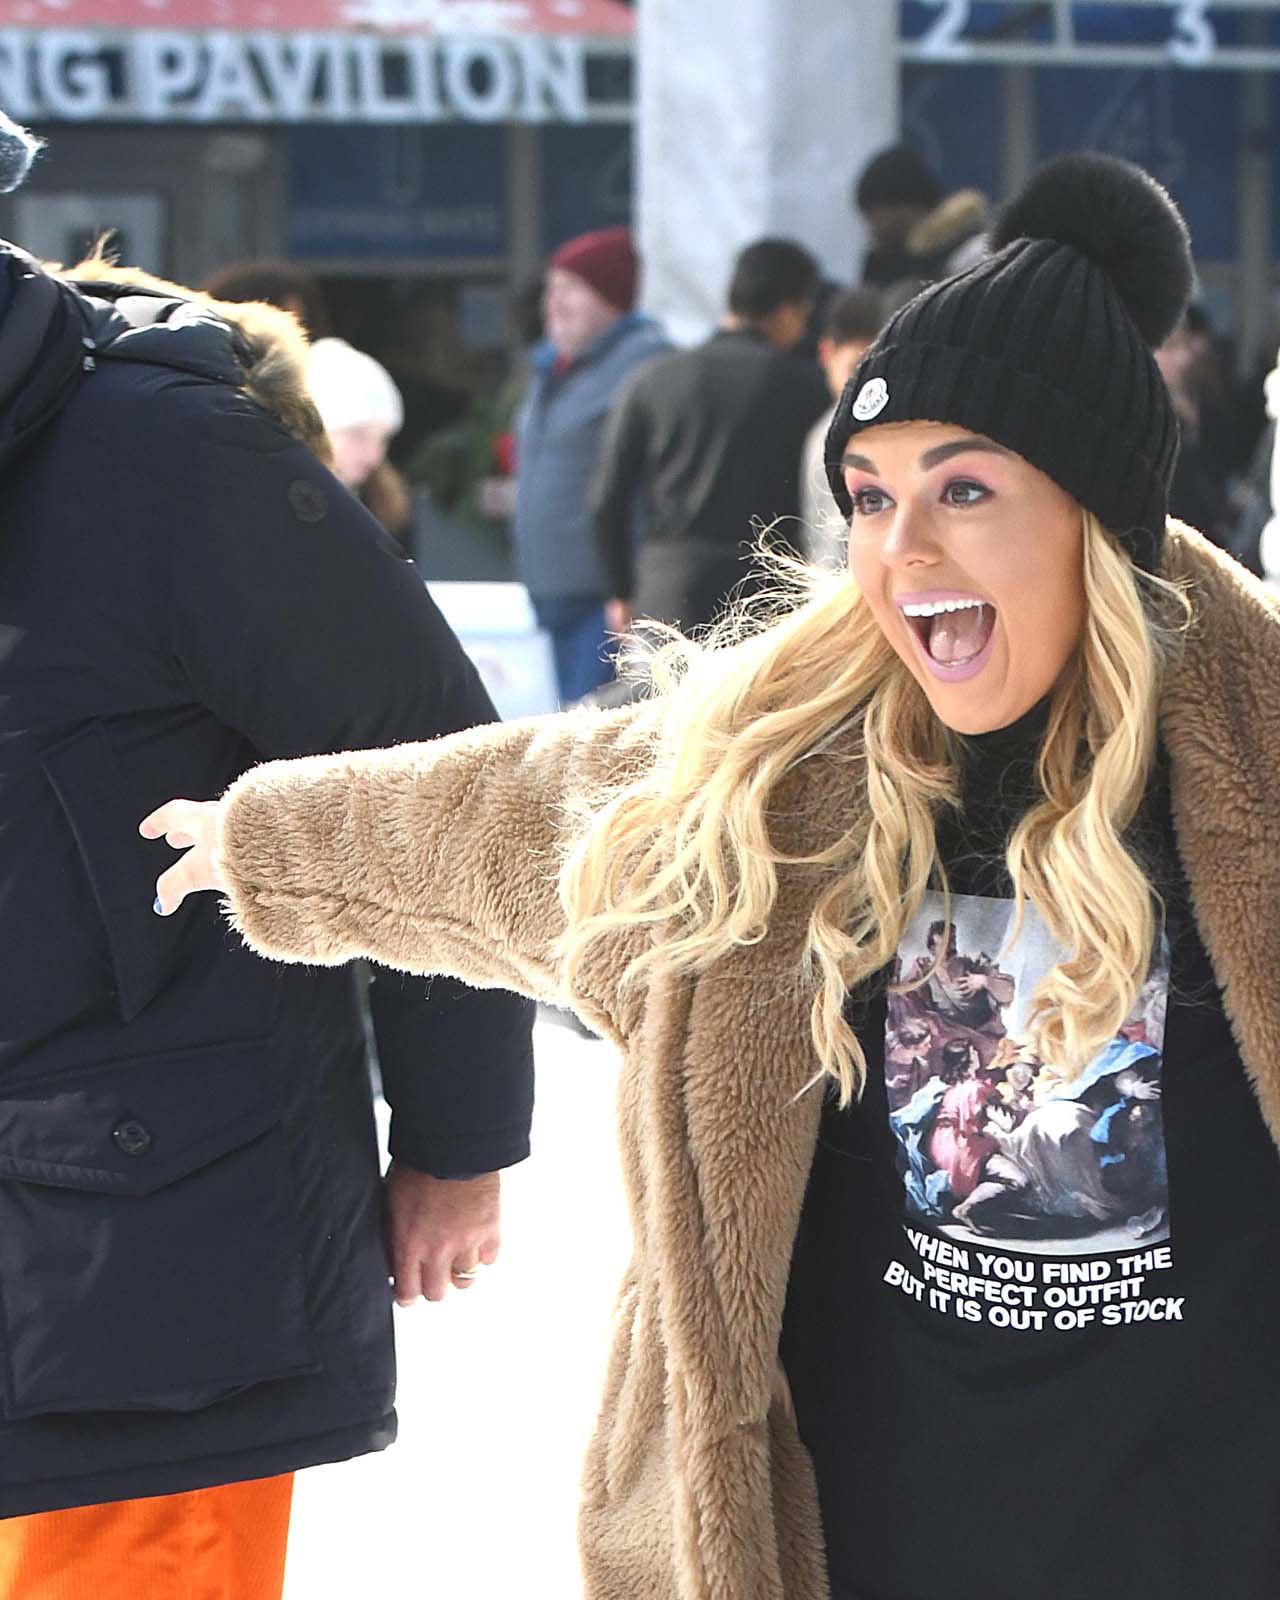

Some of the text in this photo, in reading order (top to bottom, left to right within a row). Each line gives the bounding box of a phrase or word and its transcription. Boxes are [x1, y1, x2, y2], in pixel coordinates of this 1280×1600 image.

[918, 0, 975, 59] 2
[1166, 0, 1216, 66] 3
[134, 34, 588, 121] PAVILION
[884, 1261, 1184, 1330] BUT IT IS OUT OF STOCK
[923, 1261, 1145, 1308] PERFECT OUTFIT
[976, 1253, 1034, 1282] YOU
[1042, 1261, 1110, 1283] FIND
[1116, 1247, 1172, 1275] THE
